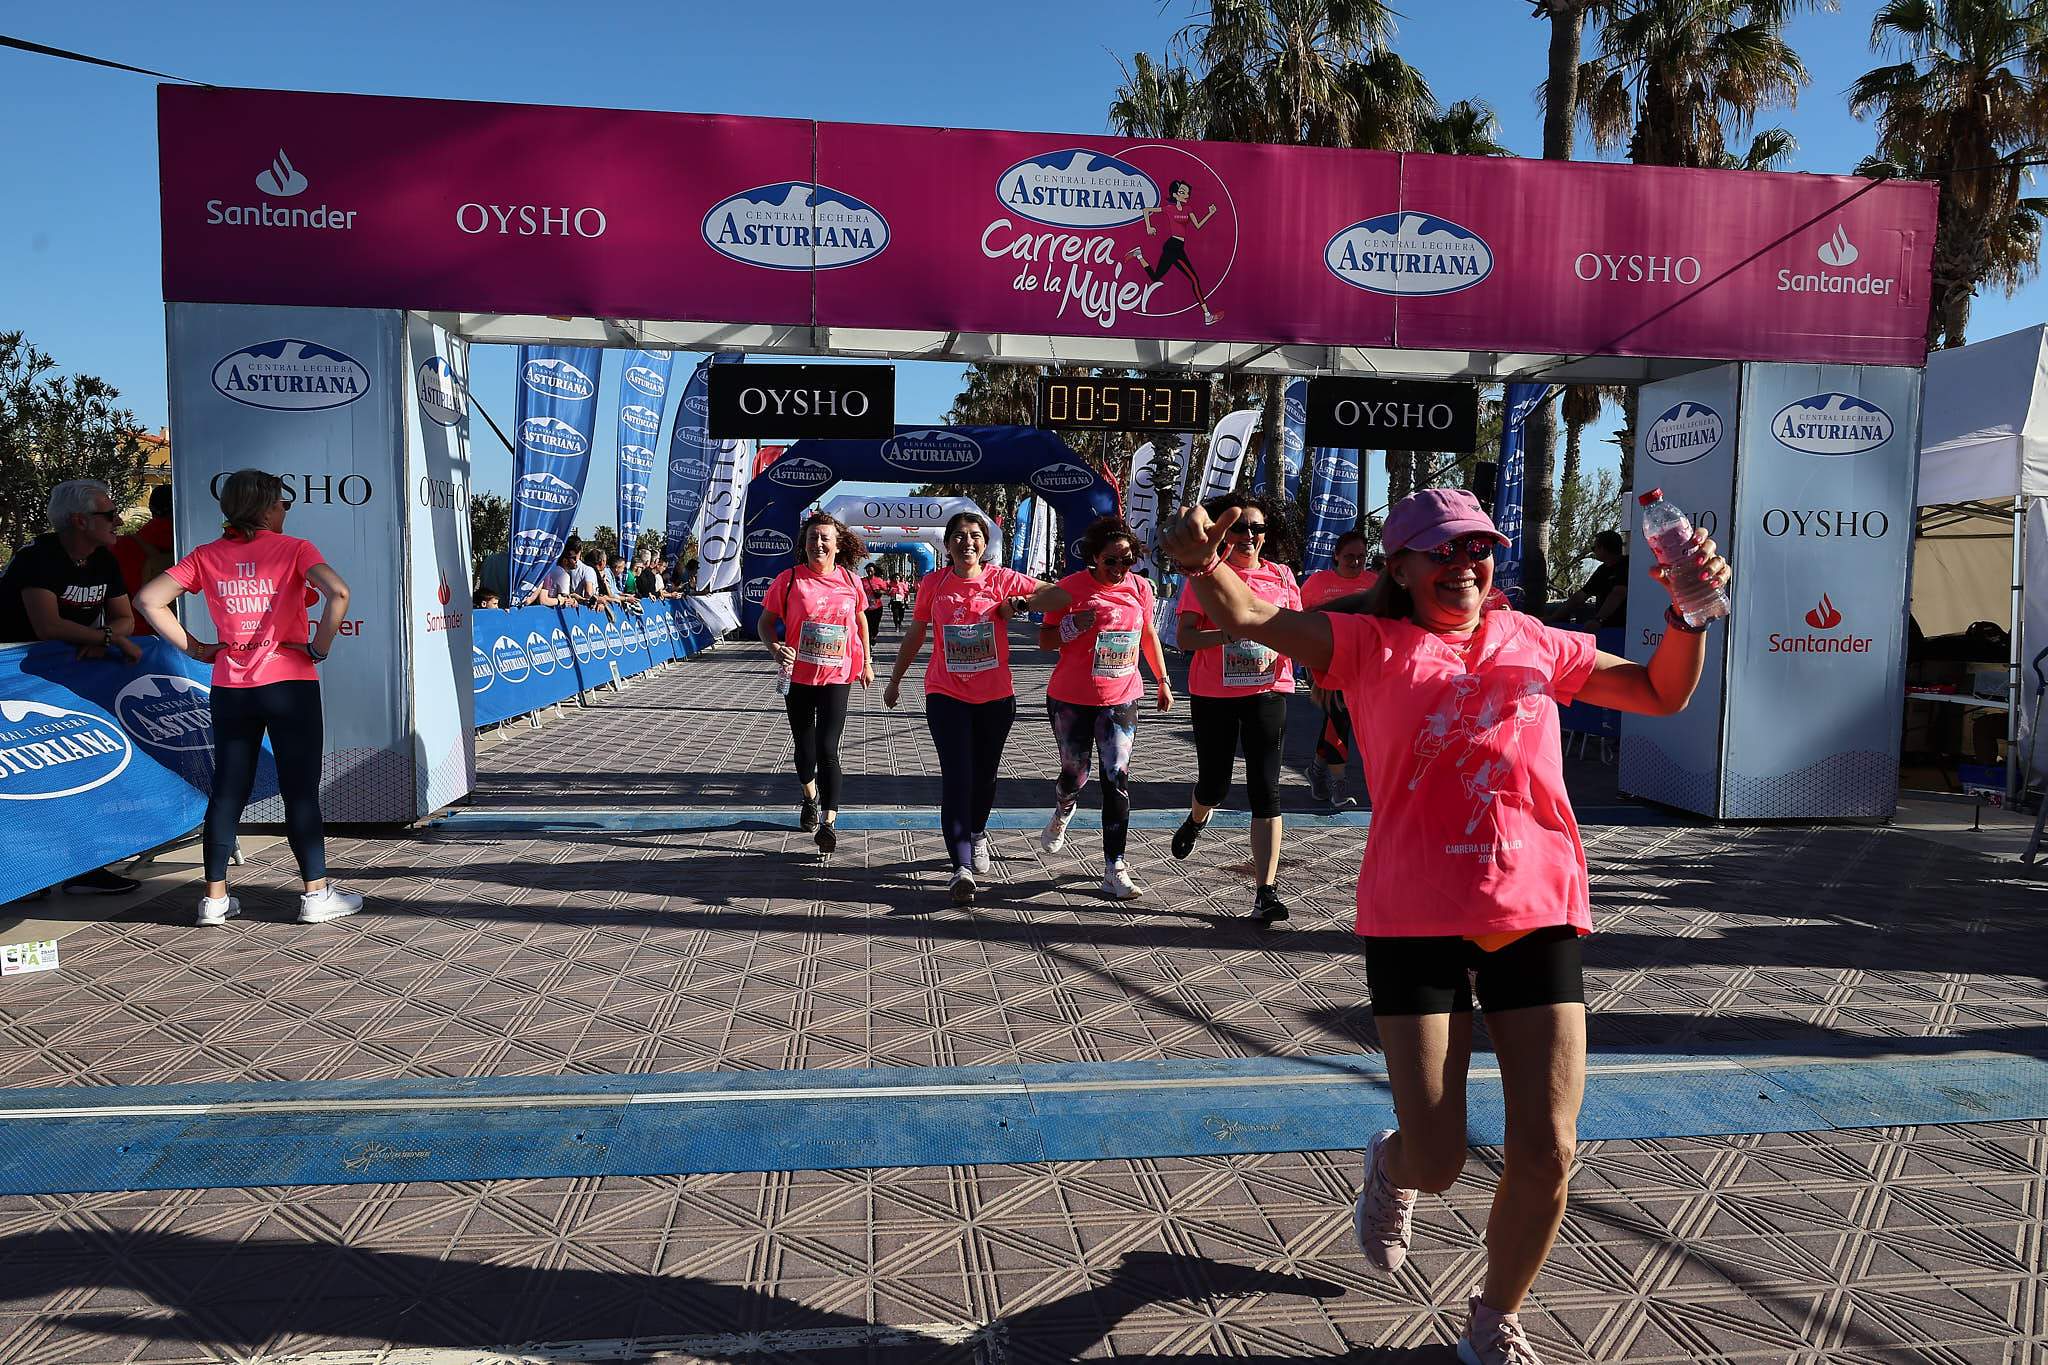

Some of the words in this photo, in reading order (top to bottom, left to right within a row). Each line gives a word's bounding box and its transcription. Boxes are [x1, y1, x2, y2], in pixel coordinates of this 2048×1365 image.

[1008, 174, 1148, 210] ASTURIANA
[1035, 174, 1087, 185] CENTRAL
[1091, 177, 1143, 188] LECHERA
[206, 199, 357, 230] Santander
[456, 202, 608, 238] OYSHO
[746, 210, 805, 221] CENTRAL
[716, 211, 876, 249] ASTURIANA
[981, 218, 1115, 265] Carrera
[1336, 239, 1480, 276] ASTURIANA
[1364, 238, 1418, 249] CENTRAL
[1422, 240, 1476, 251] LECHERA
[1574, 252, 1701, 286] OYSHO
[1777, 268, 1894, 296] Santander
[1012, 263, 1038, 292] de
[1043, 263, 1062, 293] la
[1056, 261, 1165, 329] Mujer
[223, 363, 359, 395] ASTURIANA
[248, 363, 298, 372] CENTRAL
[303, 364, 353, 374] LECHERA
[525, 366, 589, 396] ASTURIANA
[738, 387, 870, 418] OYSHO
[1050, 385, 1197, 423] 00:57:37
[1333, 399, 1454, 431] OYSHO
[1779, 414, 1885, 441] ASTURIANA
[1799, 413, 1839, 421] CENTRAL
[1841, 414, 1882, 423] LECHERA
[522, 425, 582, 453] ASTURIANA
[888, 441, 975, 463] ASTURIANA
[1650, 426, 1717, 454] ASTURIANA
[772, 464, 828, 482] ASTURIANA
[1036, 474, 1090, 486] ASTURIANA
[209, 471, 373, 507] SHO
[419, 476, 466, 512] OYSHO
[863, 501, 943, 520] OYSHO
[1762, 508, 1889, 539] OYSHO
[746, 538, 790, 551] ASTURIANA
[235, 561, 256, 578] TU
[217, 579, 278, 597] DORSAL
[226, 596, 273, 615] SUMA
[426, 609, 463, 633] Santander
[1768, 633, 1873, 654] Santander
[27, 718, 90, 738] LECHERA
[1445, 843, 1479, 855] CARRERA
[1480, 843, 1491, 853] DE
